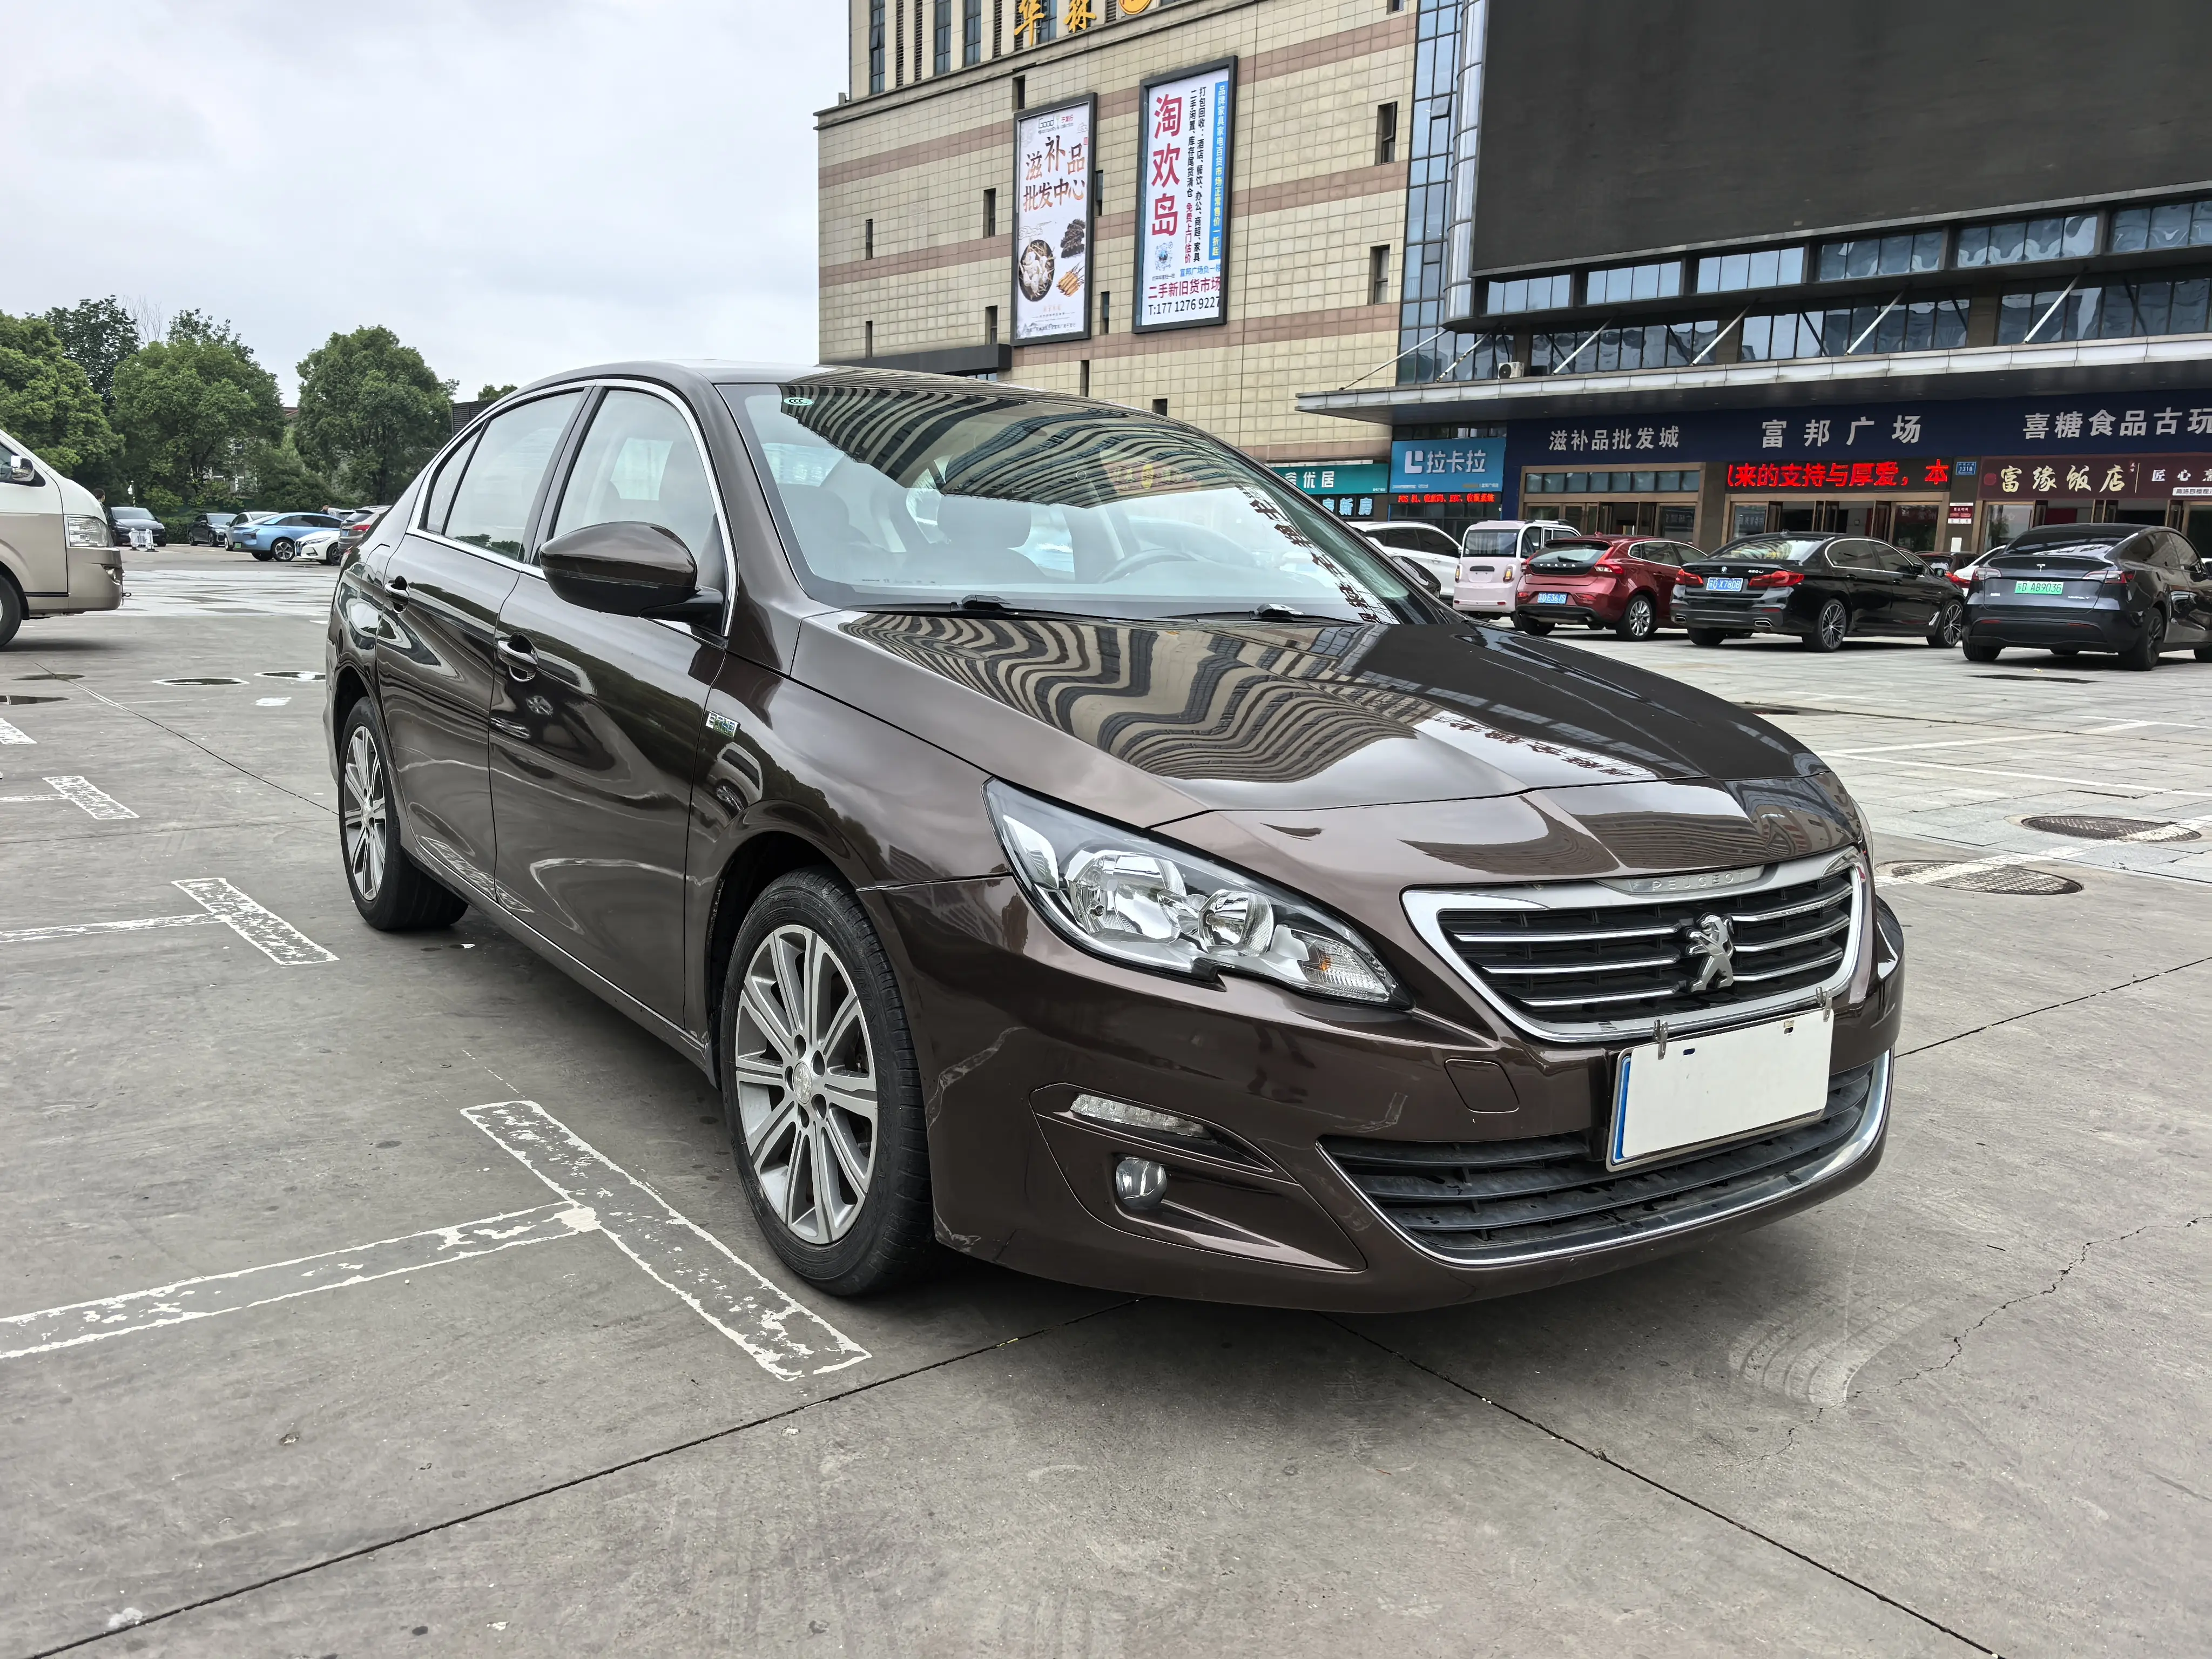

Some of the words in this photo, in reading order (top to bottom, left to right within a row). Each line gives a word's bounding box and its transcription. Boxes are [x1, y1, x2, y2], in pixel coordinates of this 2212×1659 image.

[1025, 135, 1085, 181] 滋补品
[1151, 93, 1182, 236] 淘欢岛
[1023, 178, 1085, 212] 批发中心
[1184, 203, 1193, 264] 免费上门估价
[1148, 276, 1220, 299] 二手新旧货市场
[1148, 302, 1172, 315] T:177
[1175, 299, 1196, 312] 1276
[1762, 415, 1921, 448] 富邦广场
[2023, 407, 2212, 439] 喜糖食品古玩
[1549, 426, 1680, 451] 滋补品批发城
[1426, 449, 1486, 474] 拉卡拉
[2000, 464, 2125, 493] 富缘饭店
[1652, 872, 1746, 891] PEUGEOT
